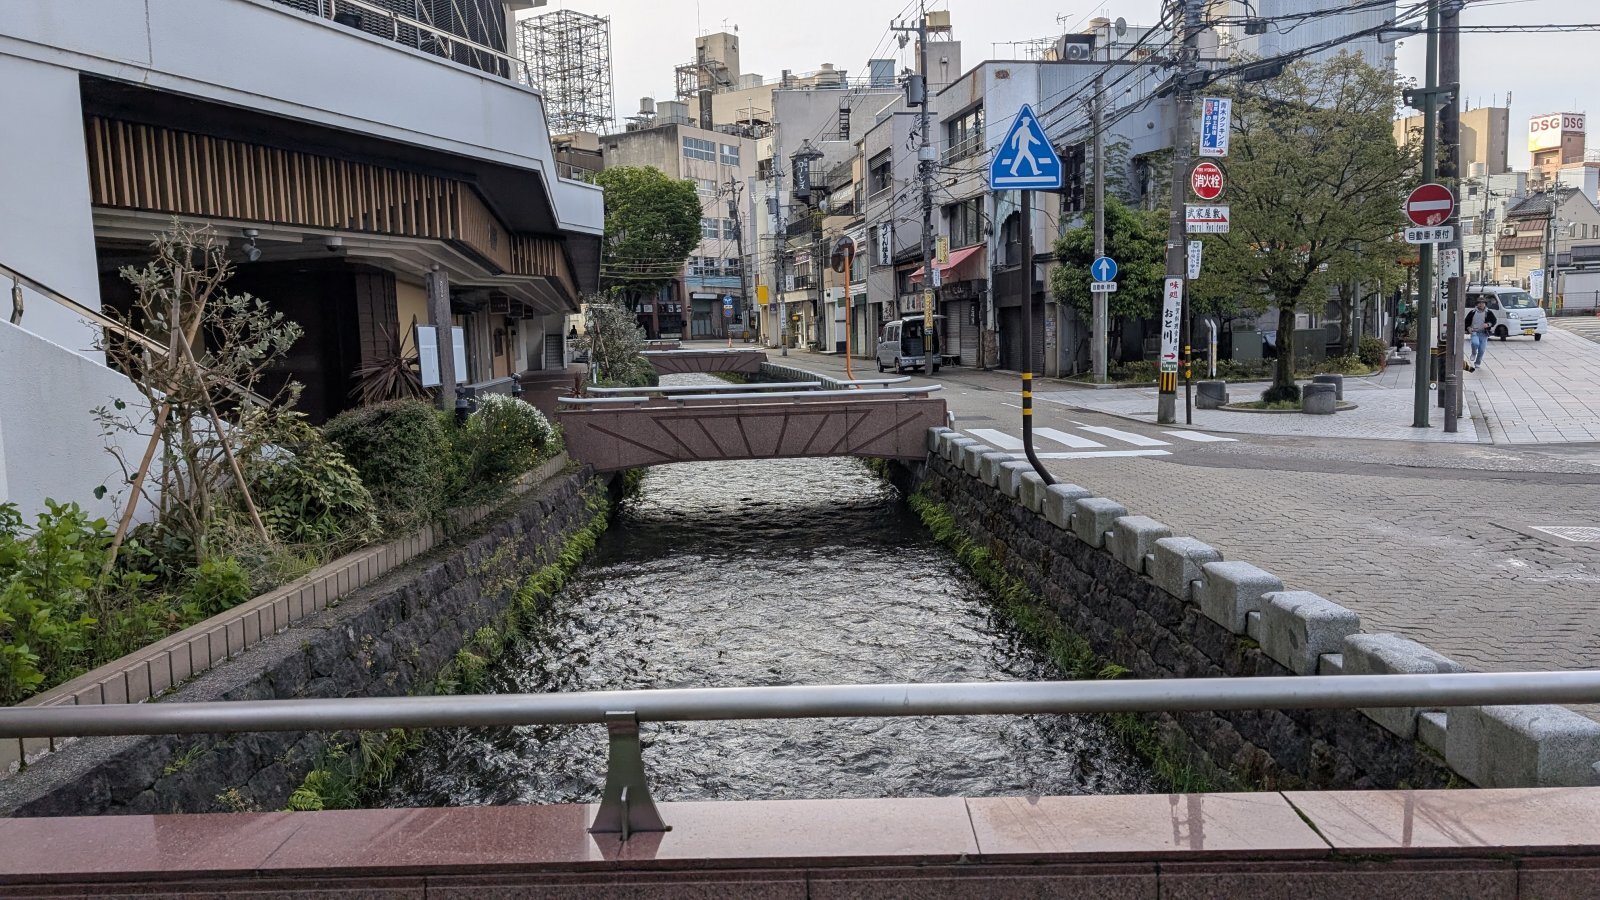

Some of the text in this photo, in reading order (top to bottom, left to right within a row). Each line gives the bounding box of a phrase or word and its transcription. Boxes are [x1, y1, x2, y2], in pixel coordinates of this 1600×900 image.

[1218, 102, 1227, 147] 青木クッキング
[1530, 117, 1560, 133] DSG
[1563, 117, 1584, 129] DSG
[1195, 174, 1220, 188] 消火栓
[1187, 208, 1221, 219] 武家屋敷
[1186, 223, 1229, 232] Samurai Residence
[1409, 230, 1449, 240] 自動車・原付
[1169, 281, 1179, 299] 味処
[1164, 308, 1173, 344] おと川
